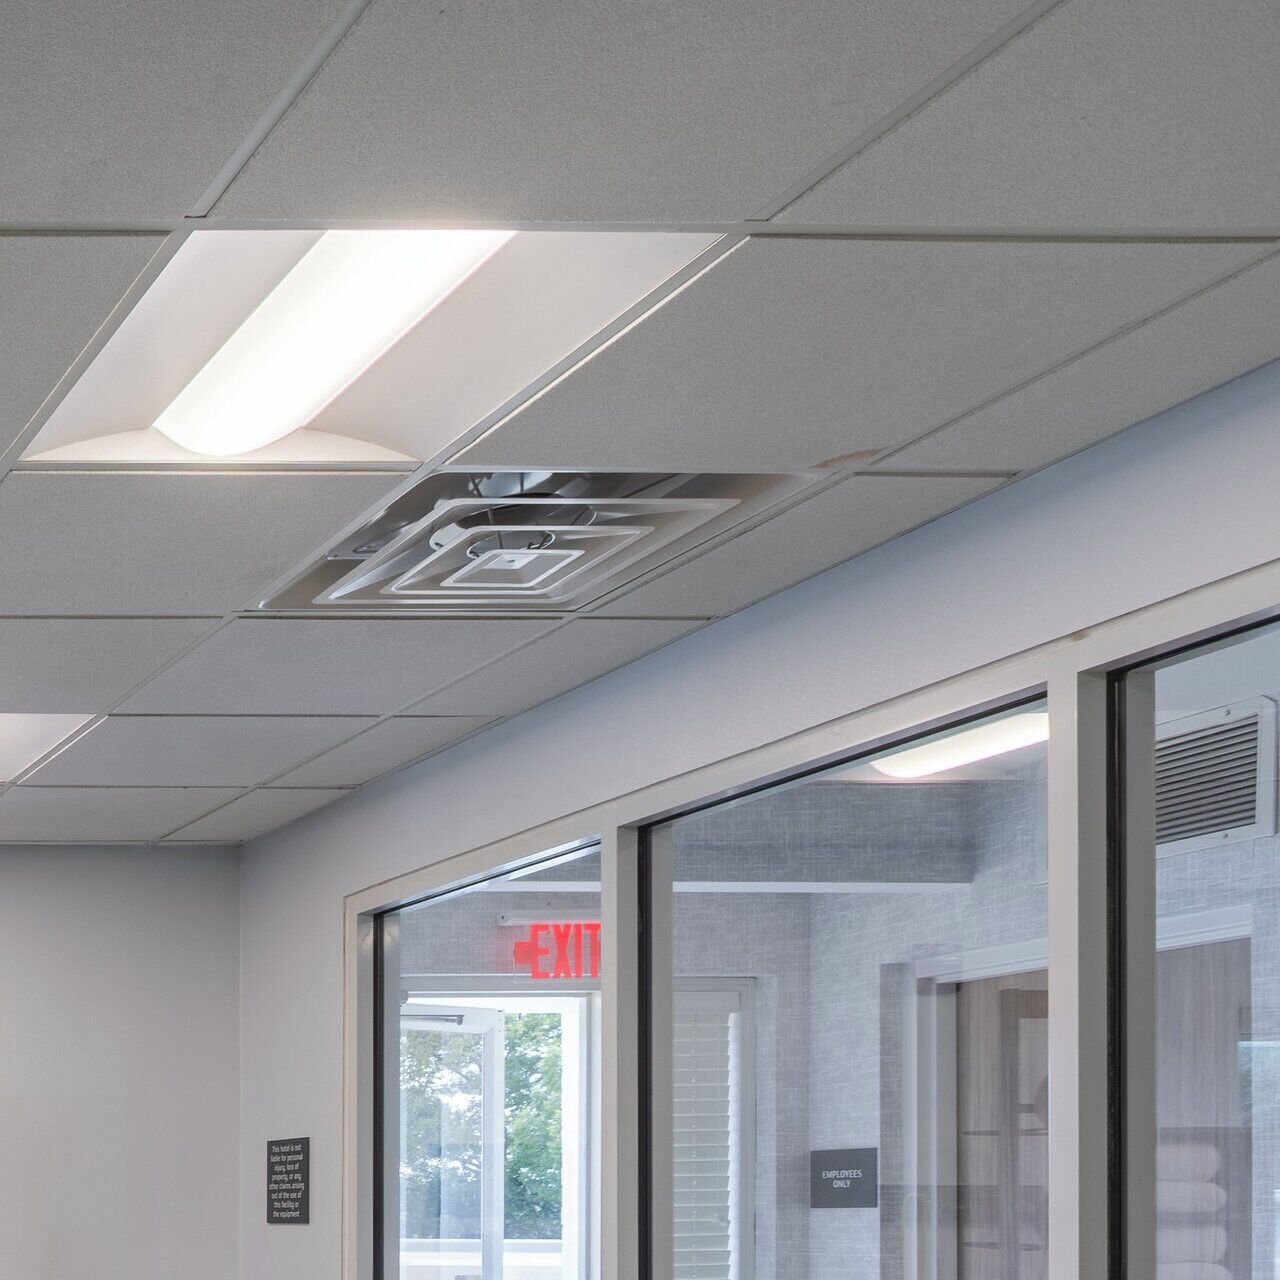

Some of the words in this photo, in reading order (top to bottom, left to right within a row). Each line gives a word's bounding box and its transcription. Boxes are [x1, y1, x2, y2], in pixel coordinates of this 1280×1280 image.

[531, 923, 601, 979] EXIT
[287, 1153, 303, 1162] personal
[822, 1169, 862, 1179] EMPLOYEES
[832, 1180, 851, 1188] ONLY
